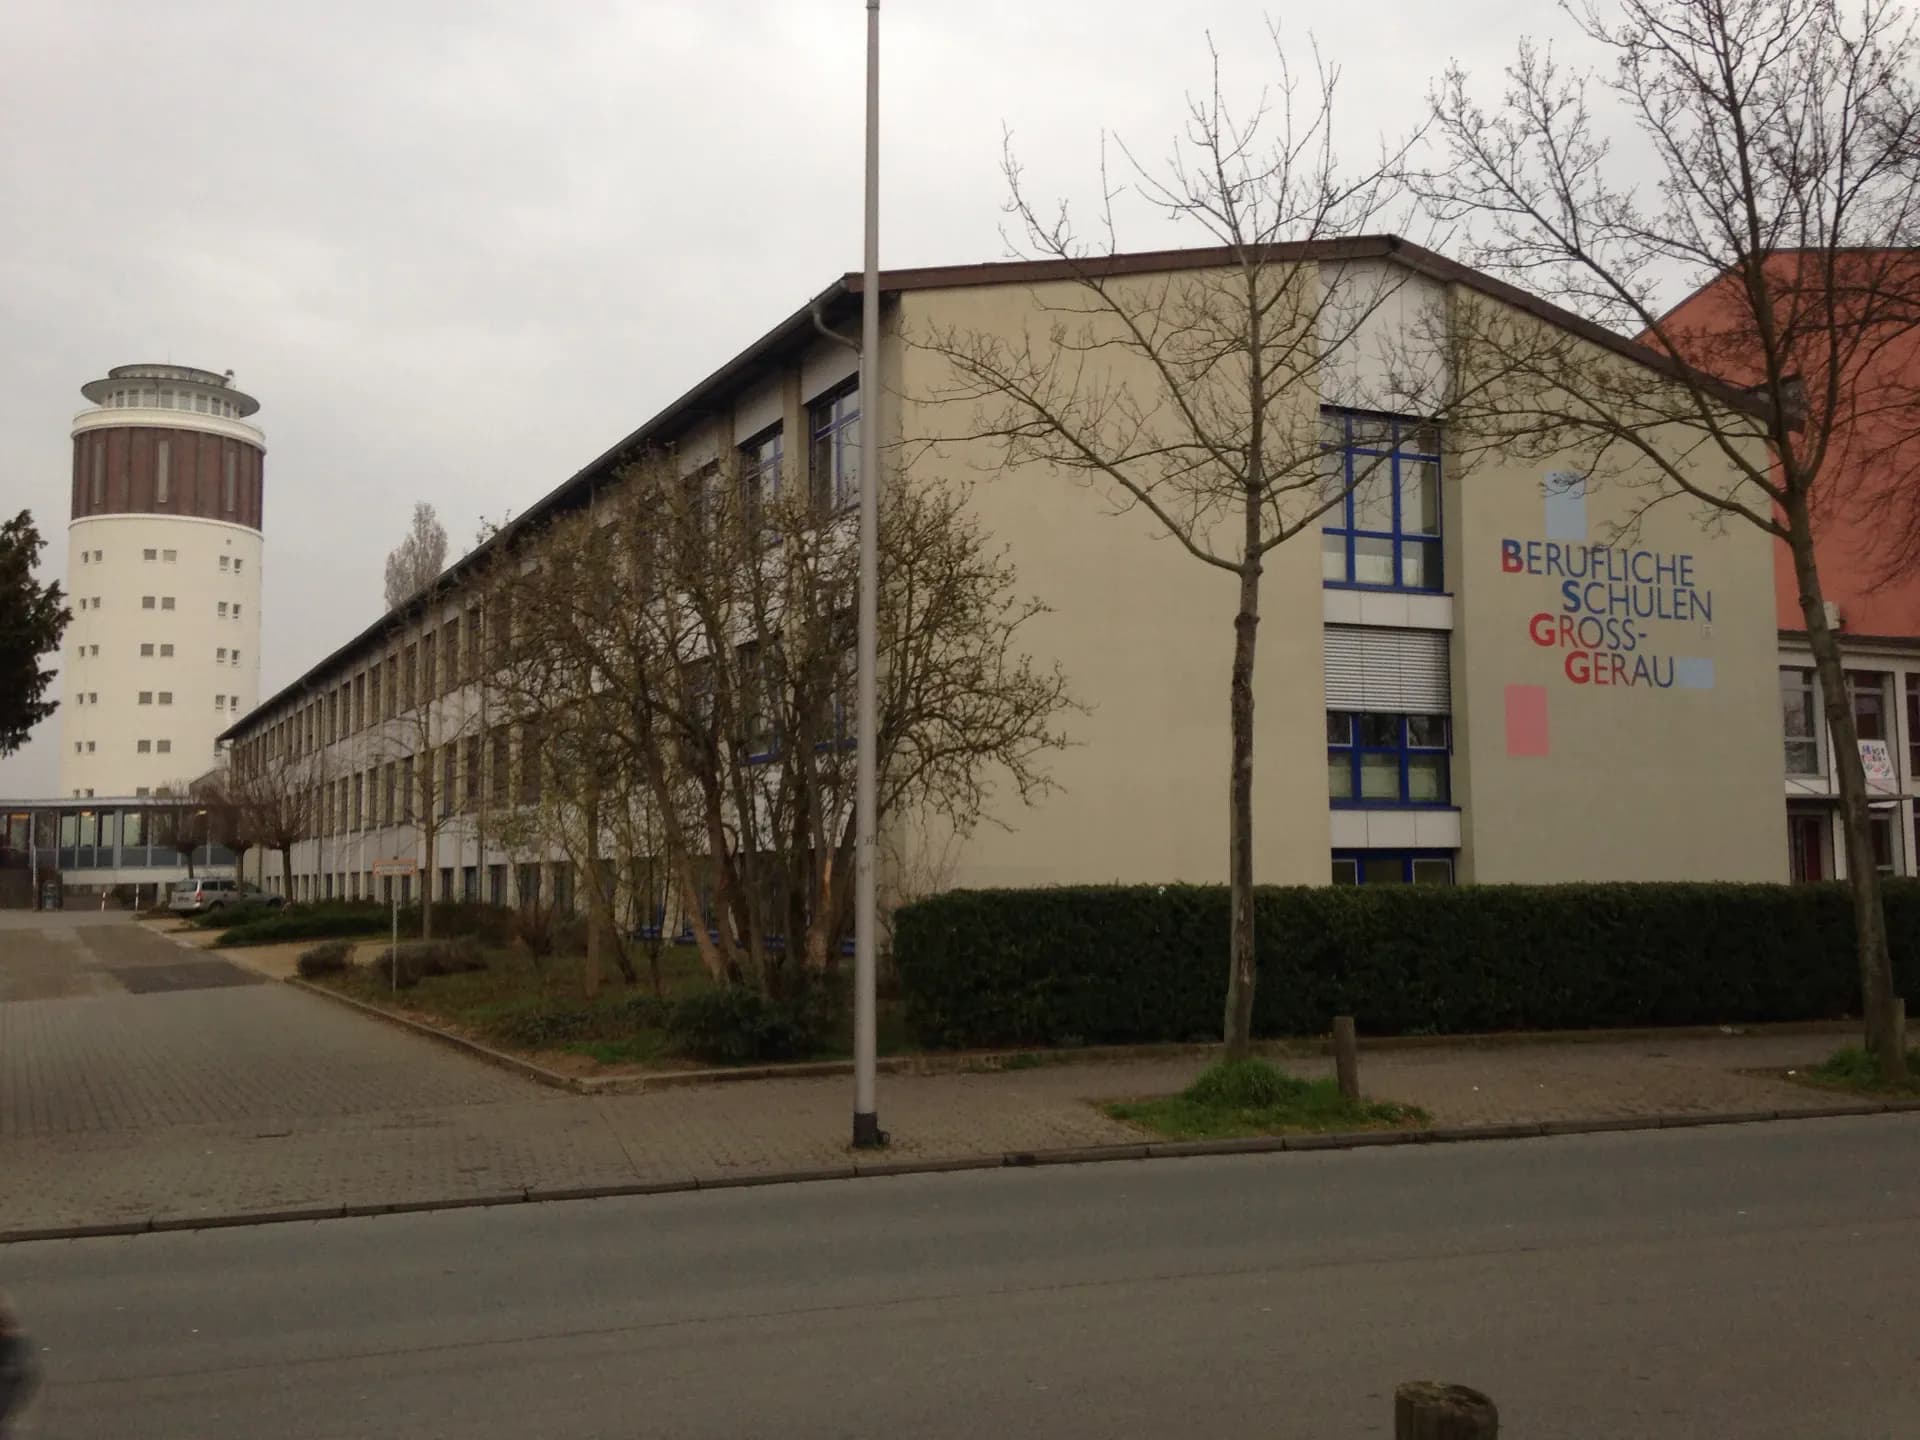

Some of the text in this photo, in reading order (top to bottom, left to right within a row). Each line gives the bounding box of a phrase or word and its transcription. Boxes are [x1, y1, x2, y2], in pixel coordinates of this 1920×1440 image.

[1502, 539, 1695, 587] BERUFLICHE
[1562, 580, 1712, 622] SCHULEN
[1529, 613, 1647, 651] GROSS-
[1564, 651, 1674, 688] GERAU
